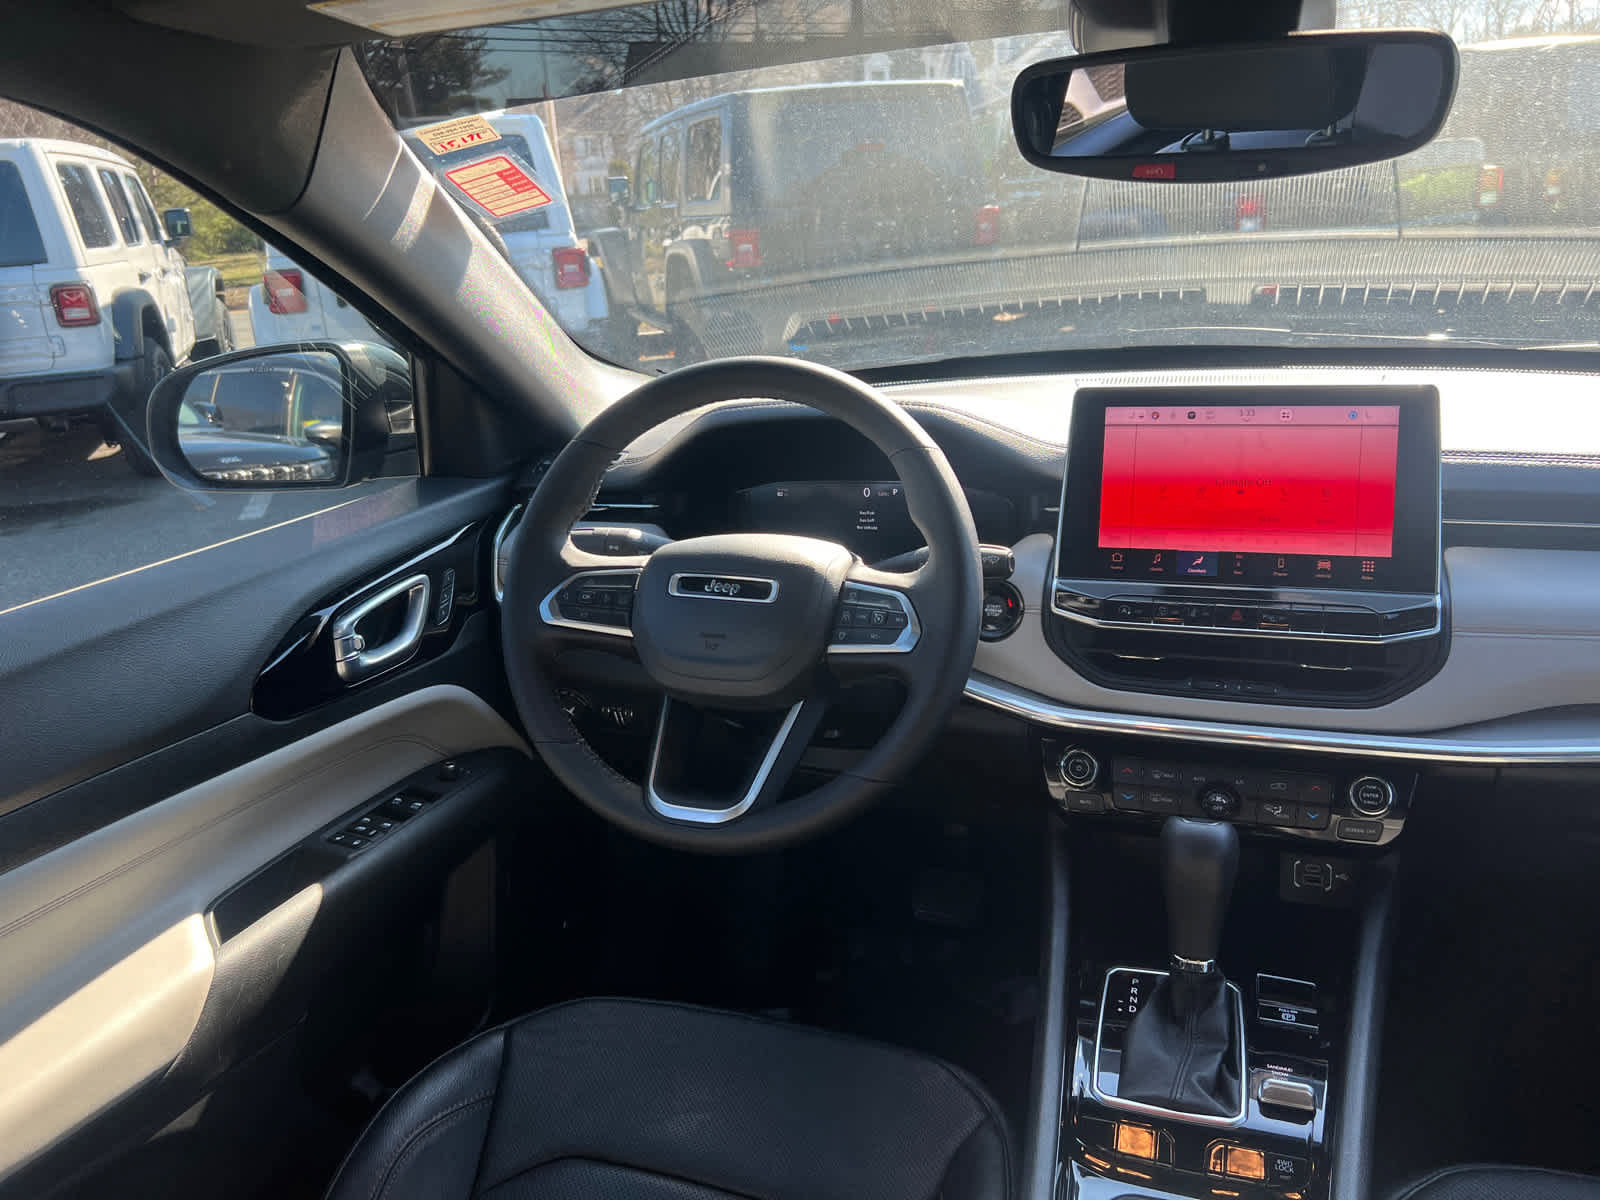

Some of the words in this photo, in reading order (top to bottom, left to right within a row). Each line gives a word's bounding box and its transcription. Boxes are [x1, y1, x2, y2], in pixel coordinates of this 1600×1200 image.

[863, 487, 871, 498] 0
[892, 488, 898, 496] P
[704, 579, 741, 596] Jeep
[1131, 977, 1140, 985] P
[1130, 987, 1138, 995] R
[1129, 996, 1138, 1004] N
[1128, 1005, 1137, 1013] D
[1276, 1158, 1293, 1168] 4WD
[1274, 1163, 1295, 1174] LOCK
